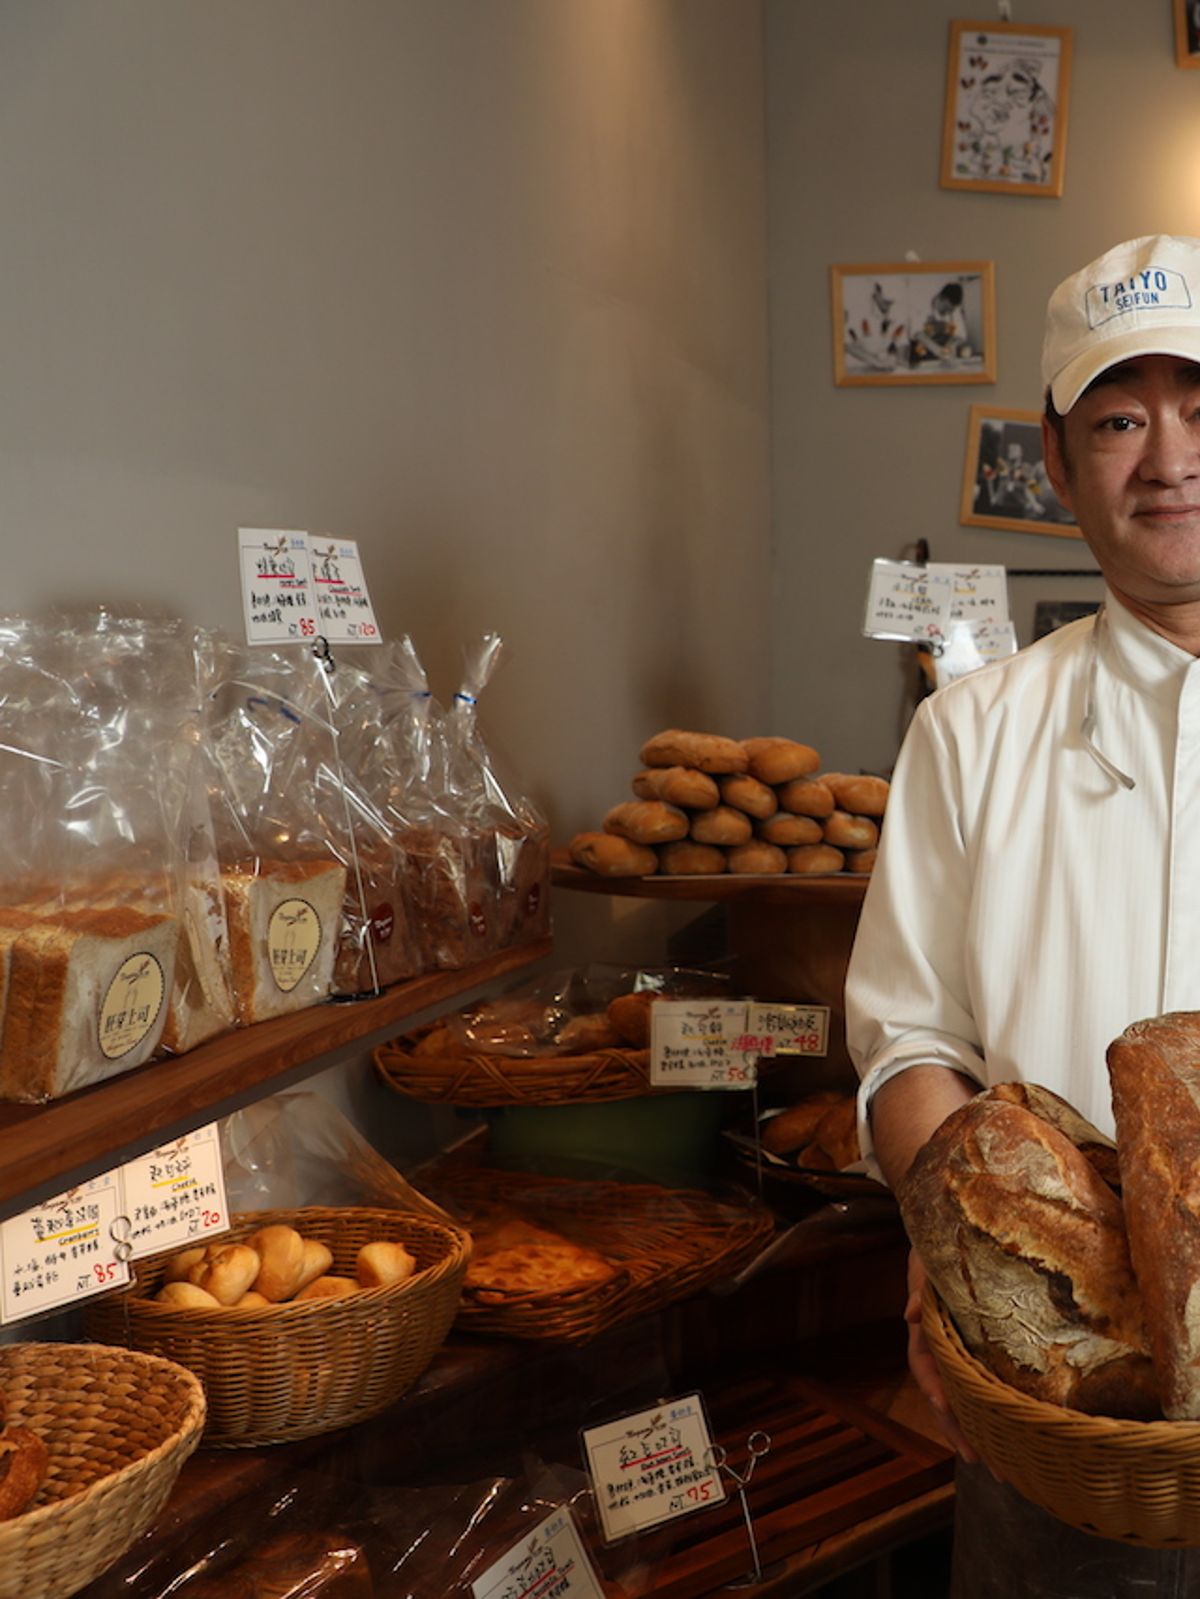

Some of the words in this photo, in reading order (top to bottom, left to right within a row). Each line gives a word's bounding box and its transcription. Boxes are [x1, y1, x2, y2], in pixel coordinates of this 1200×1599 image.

[1101, 271, 1167, 303] TAIYO
[1115, 292, 1159, 311] SEIFUN
[300, 618, 315, 636] 85
[792, 1033, 820, 1052] 48
[726, 1066, 746, 1082] 50
[201, 1209, 220, 1228] 20
[93, 1261, 118, 1283] 85
[687, 1480, 713, 1501] 75
